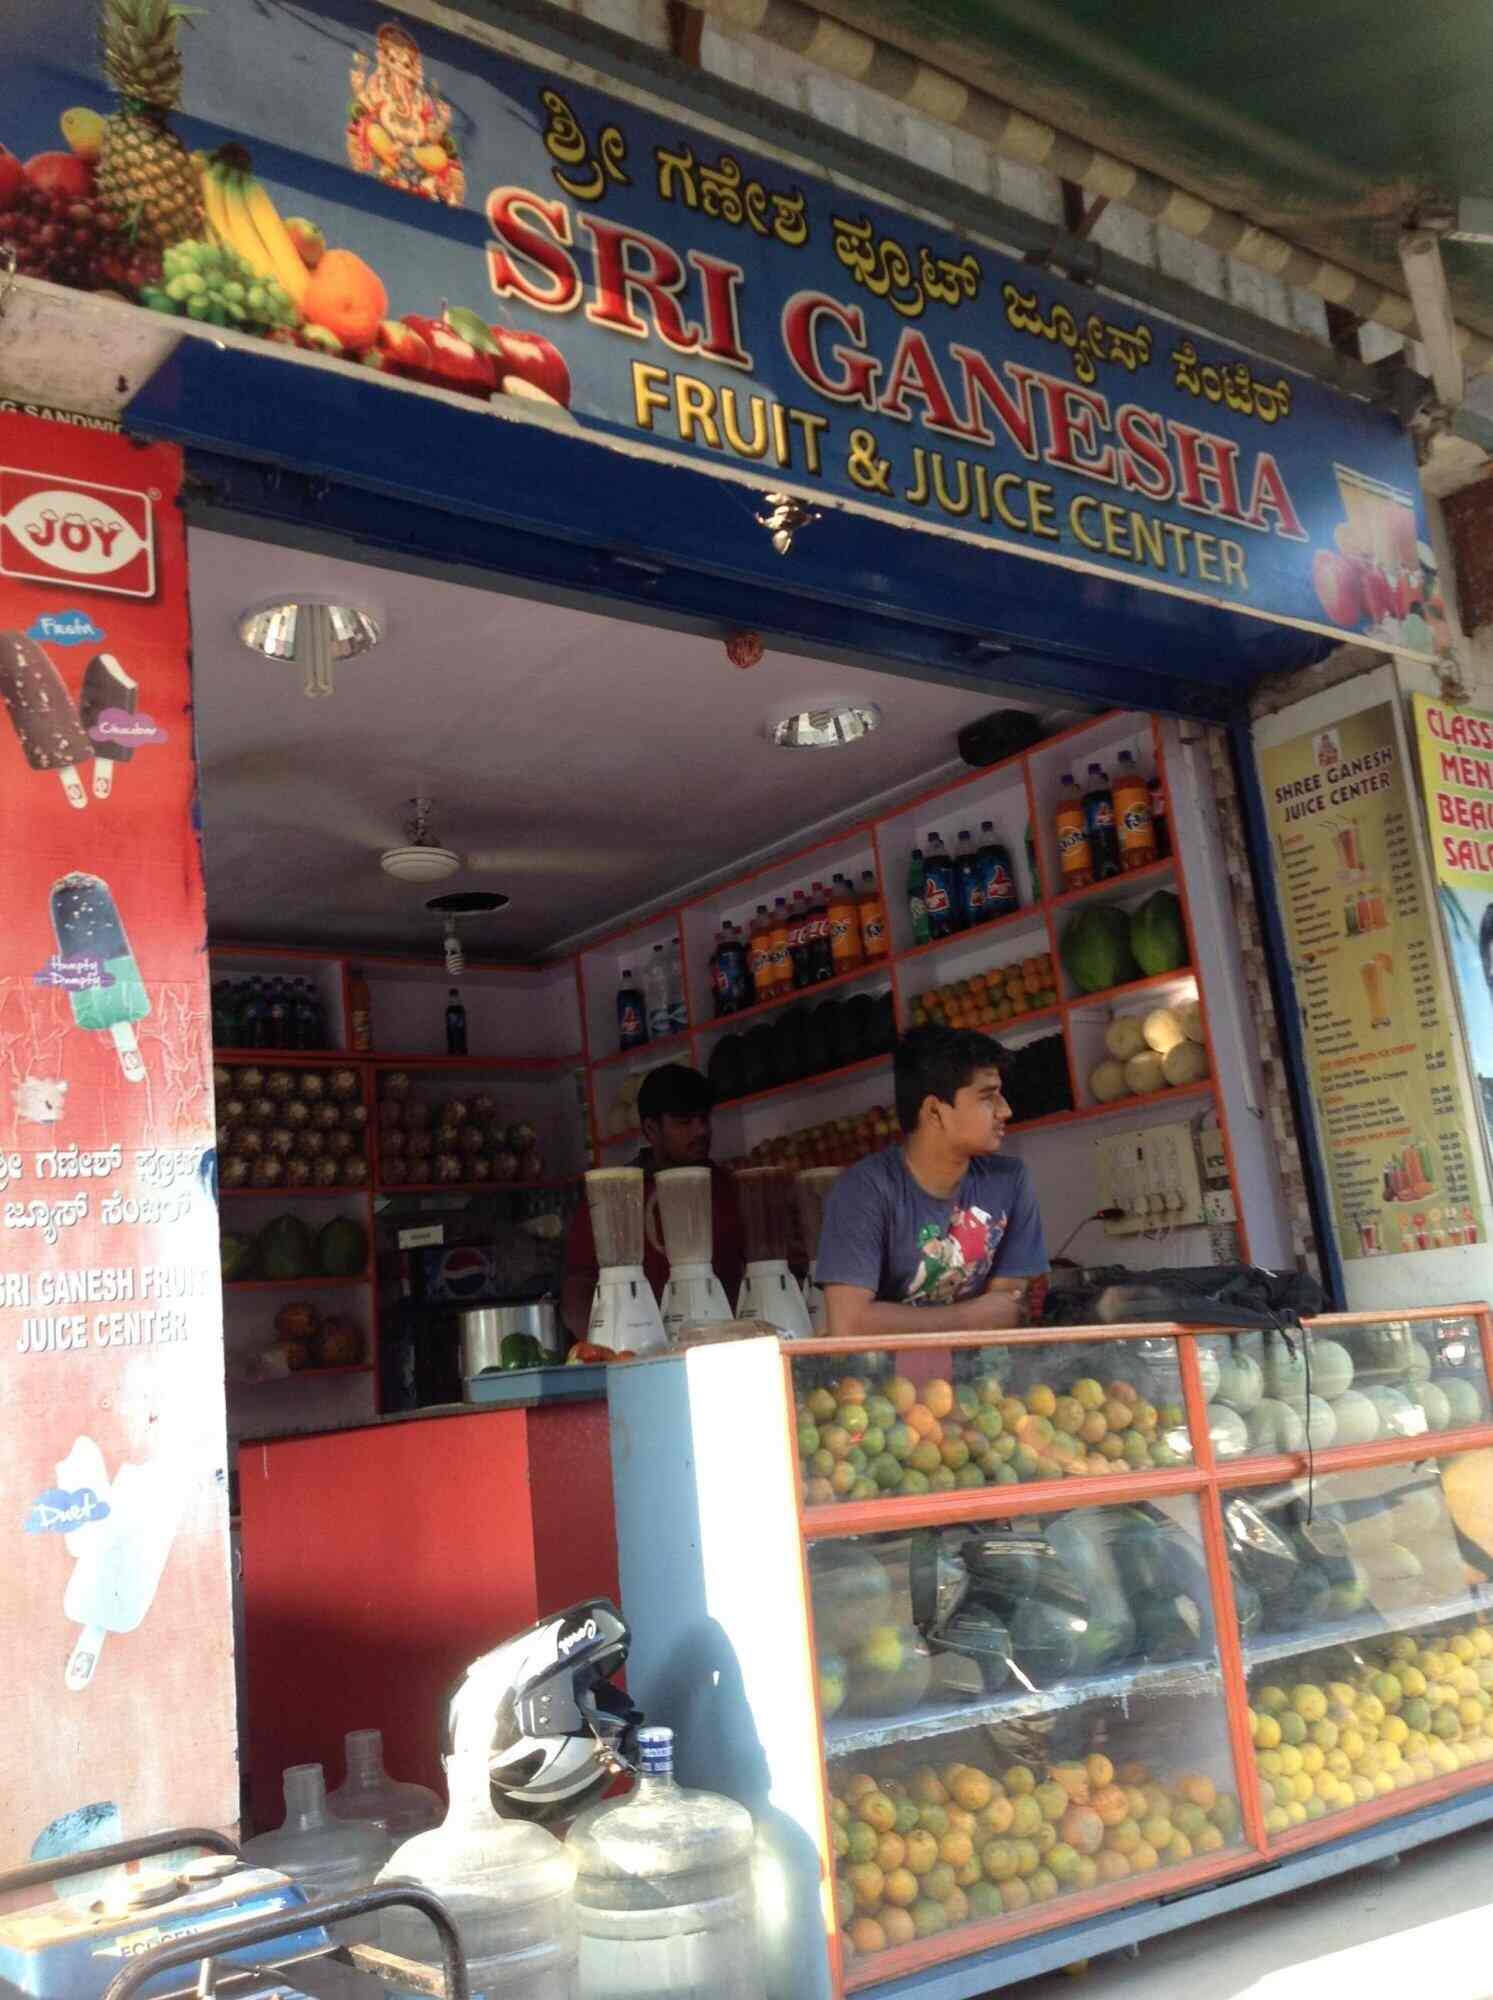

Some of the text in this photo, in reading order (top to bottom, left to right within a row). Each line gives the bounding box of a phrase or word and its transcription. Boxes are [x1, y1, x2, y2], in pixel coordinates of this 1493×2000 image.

[539, 88, 632, 202] ಶ್ರೀ
[655, 147, 808, 247] ಗಣೇಶ
[486, 186, 1311, 543] SRI GANESHA
[630, 359, 1250, 591] FRUIT & JUICE CENTER
[25, 509, 123, 558] JOY
[1274, 748, 1393, 804] SHREE GANESH
[1285, 772, 1392, 823] JUICE CENTER
[36, 1267, 136, 1305] GANESH
[16, 1310, 189, 1354] JUICE CENTER
